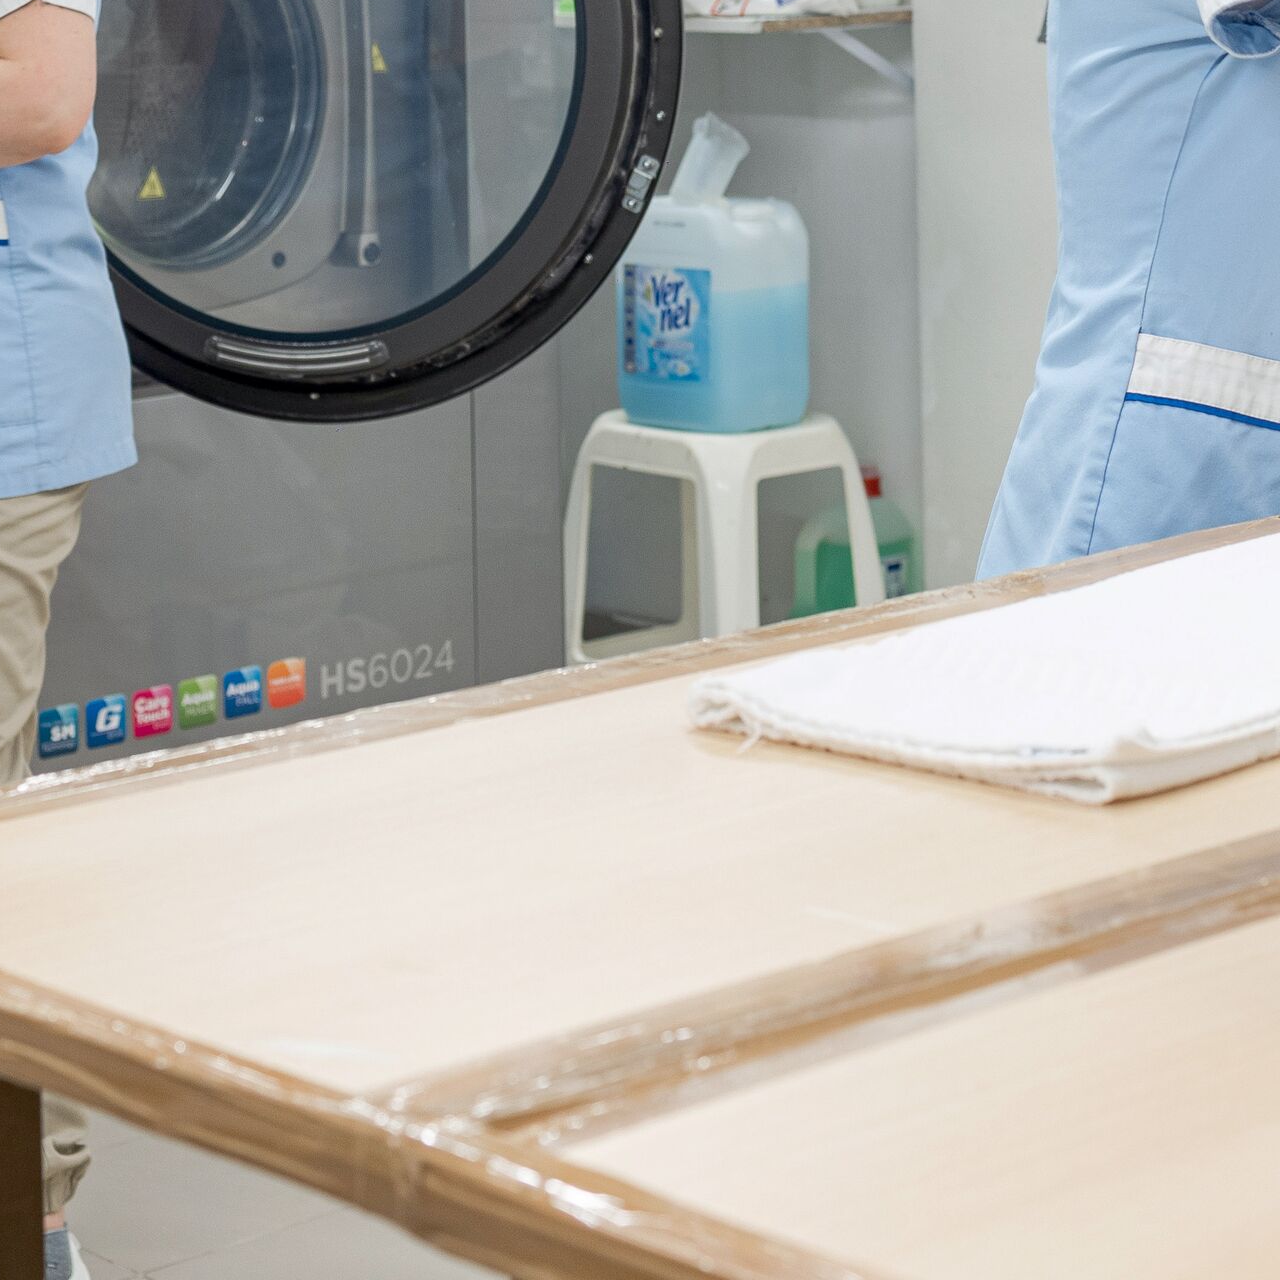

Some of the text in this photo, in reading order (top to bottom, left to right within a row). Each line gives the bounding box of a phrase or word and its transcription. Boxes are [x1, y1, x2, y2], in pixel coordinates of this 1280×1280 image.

[320, 639, 455, 699] HS6024
[225, 679, 260, 698] Aqua
[134, 696, 170, 714] Care
[95, 702, 124, 733] G
[135, 708, 171, 726] Touch
